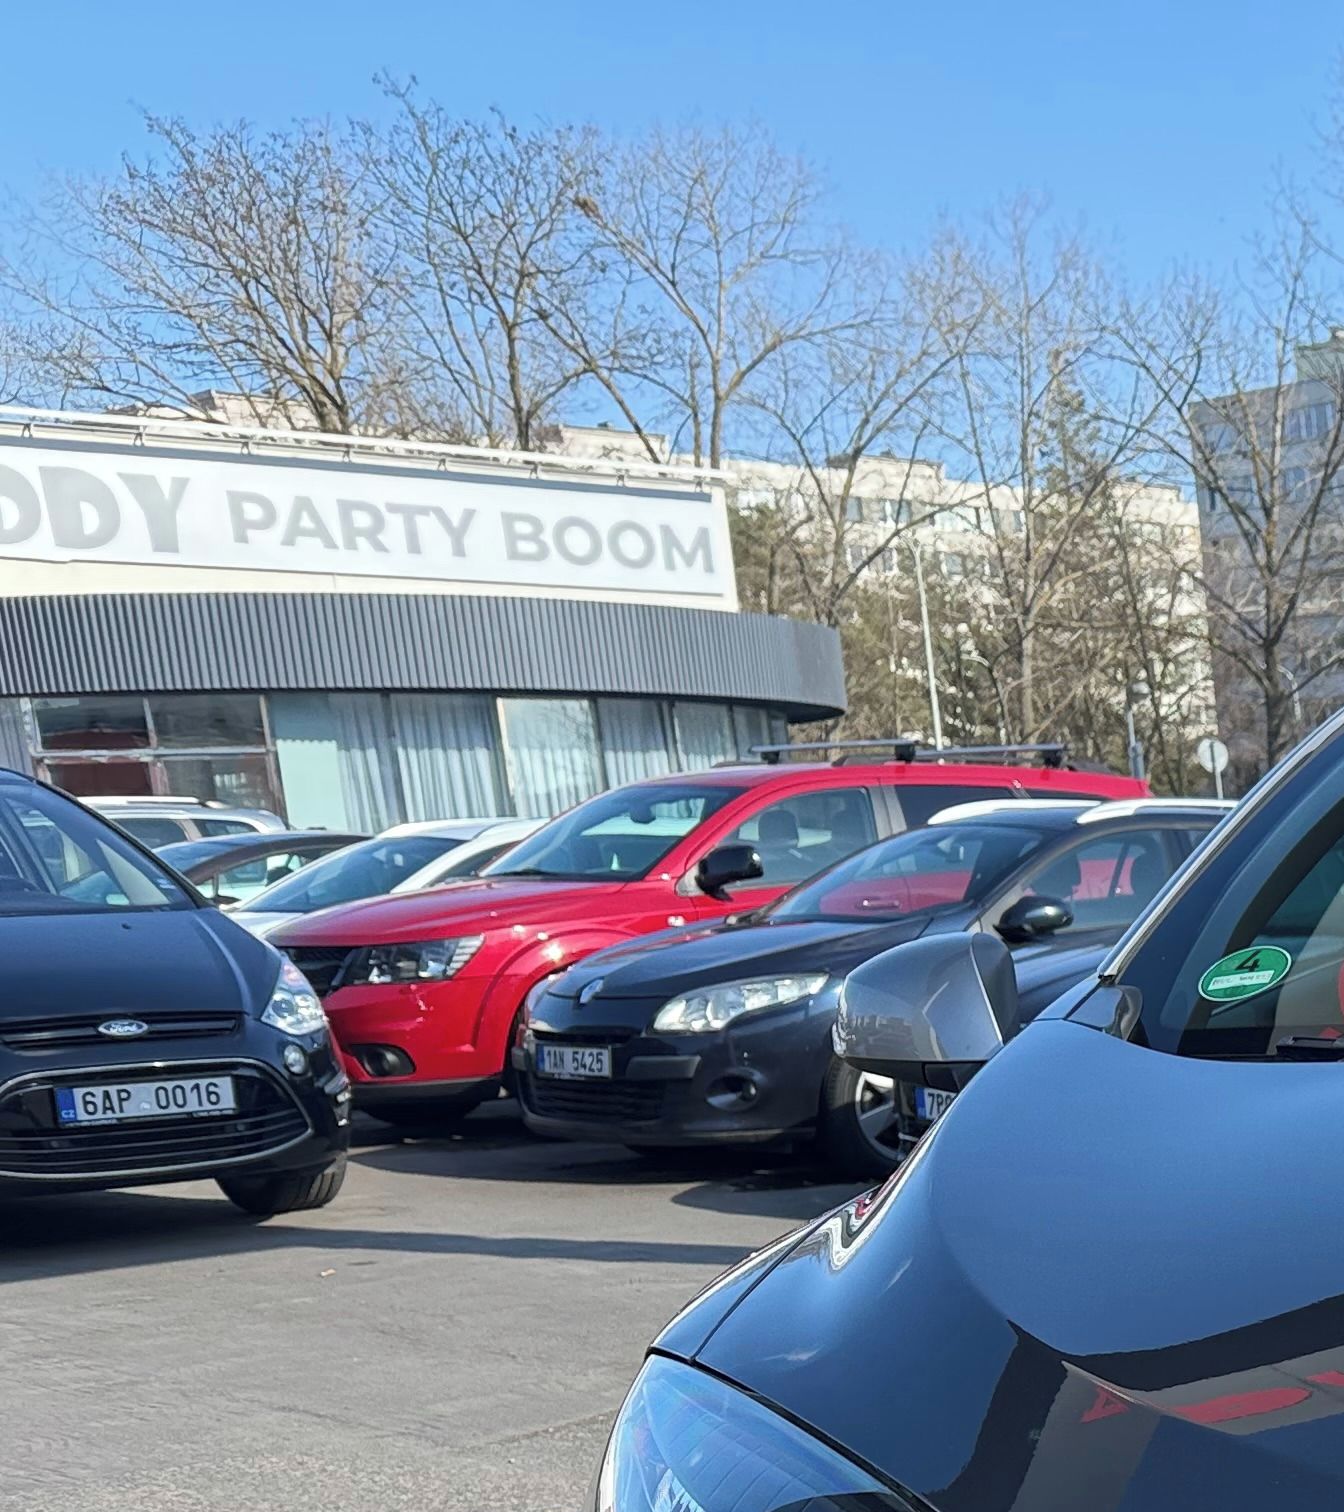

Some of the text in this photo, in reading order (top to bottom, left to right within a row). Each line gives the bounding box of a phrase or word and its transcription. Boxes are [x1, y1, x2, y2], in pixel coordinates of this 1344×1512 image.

[226, 490, 477, 557] PARTY
[500, 511, 715, 574] BOOM
[1235, 949, 1262, 973] 4
[571, 1051, 604, 1073] 5425
[61, 1081, 221, 1119] CZ 6AP 0016
